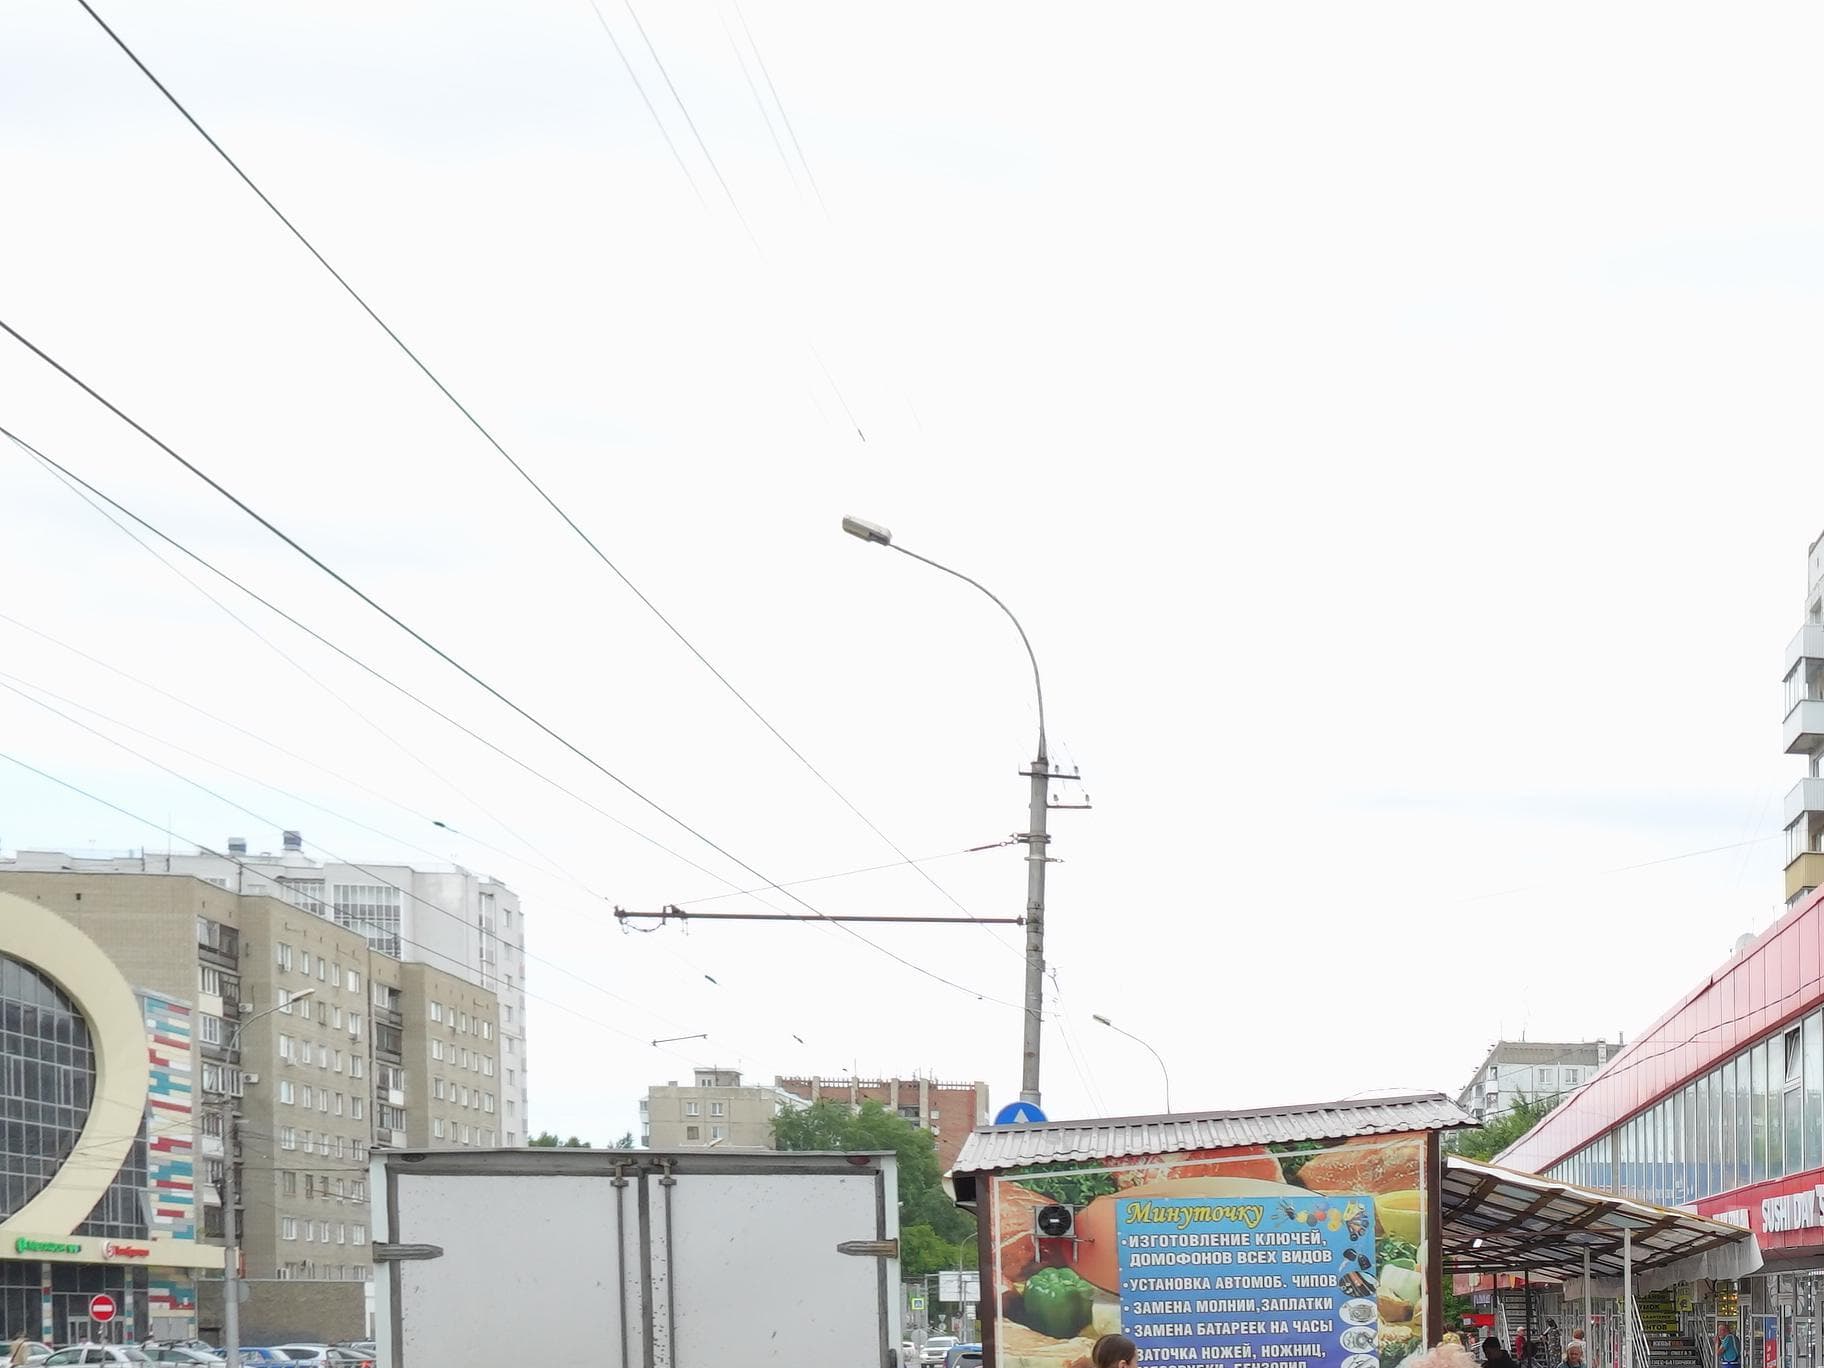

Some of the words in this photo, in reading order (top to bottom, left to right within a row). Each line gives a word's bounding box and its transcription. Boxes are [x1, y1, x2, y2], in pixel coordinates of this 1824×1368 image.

[1126, 1201, 1264, 1230] Минуточку
[1762, 1194, 1792, 1233] SUSHI
[1129, 1232, 1250, 1248] ИЗГОТОВЛЕНИЕ
[1255, 1229, 1327, 1247] КЛЮЧЕЙ,
[1129, 1251, 1232, 1267] ДОМОФОНОВ
[1237, 1250, 1277, 1264] ВСЕХ
[1281, 1249, 1332, 1264] ВИДОВ
[1129, 1276, 1211, 1292] УСТАНОВКА
[1215, 1275, 1287, 1290] АВТОМОБ.
[1292, 1274, 1337, 1288] ЧИПОВ
[1133, 1301, 1192, 1315] ЗАМЕНА
[1133, 1323, 1193, 1338] ЗАМЕНА
[1197, 1321, 1266, 1336] БАТАРЕЕК
[1270, 1320, 1289, 1334] НА
[1292, 1319, 1333, 1333] ЧАСЫ
[1136, 1347, 1197, 1361] ЗАТОЧКА
[1201, 1343, 1257, 1360] НОЖЕЙ,
[1261, 1343, 1326, 1359] НОЖНИЦ,
